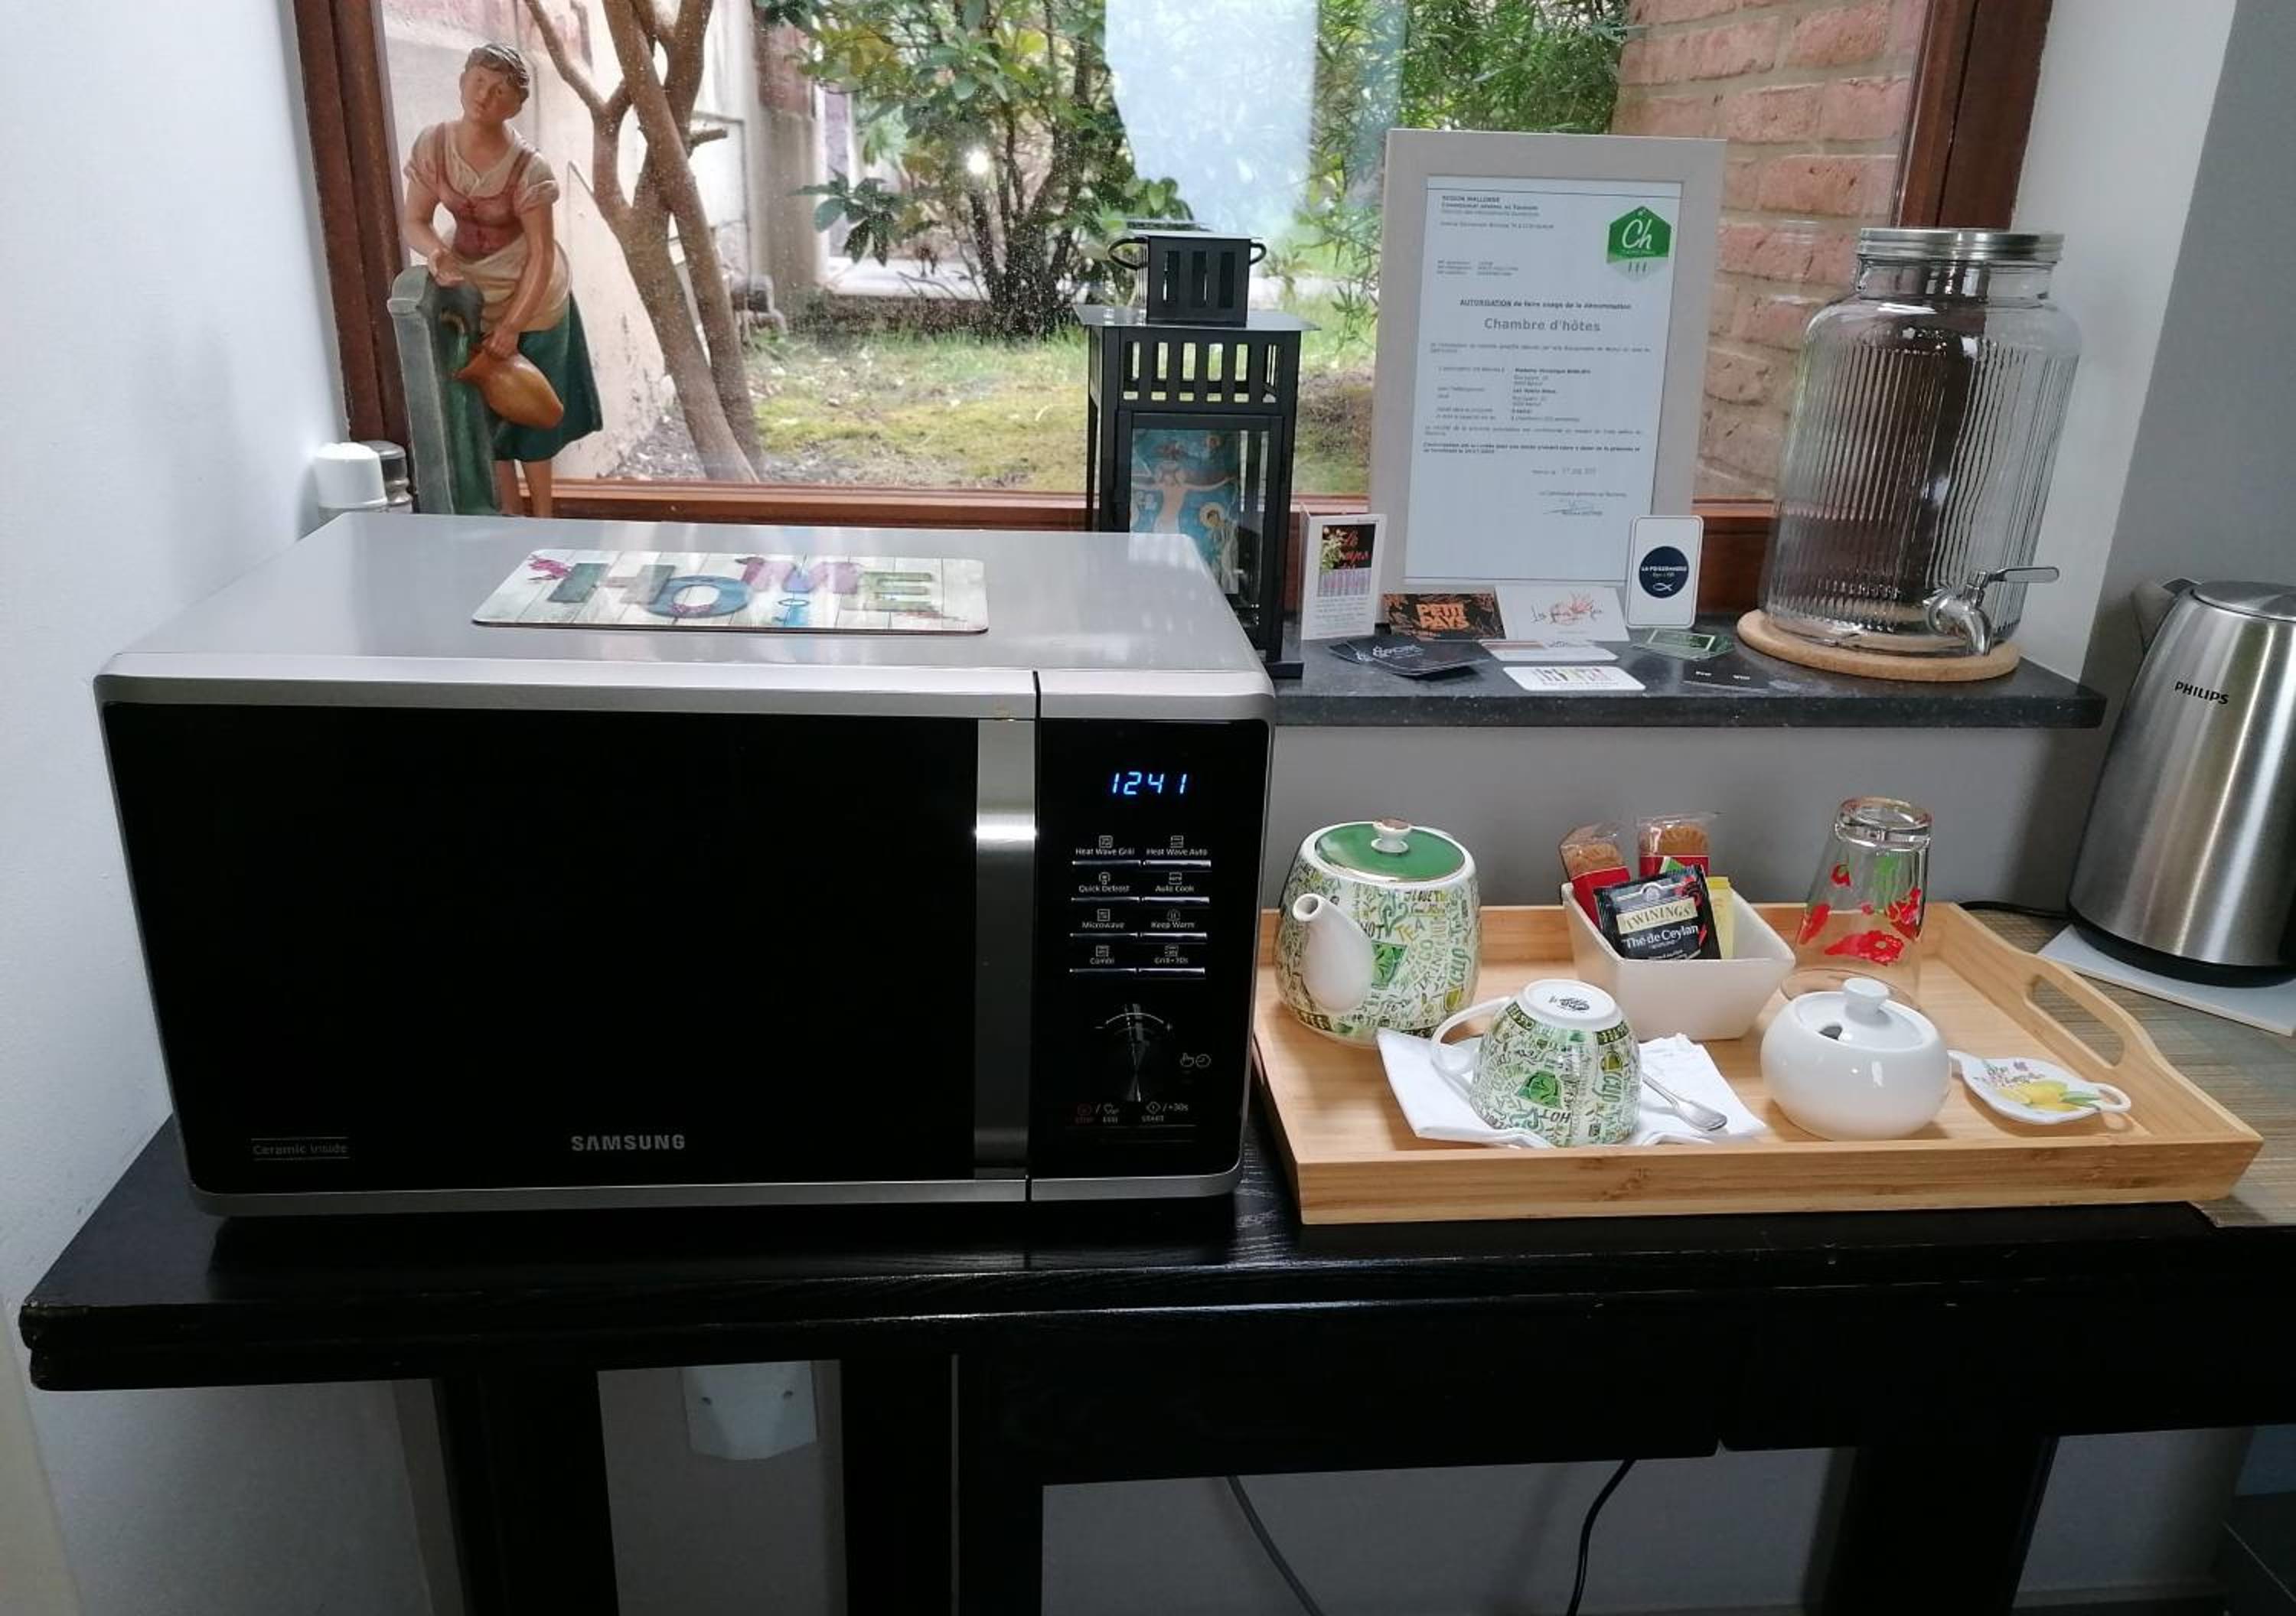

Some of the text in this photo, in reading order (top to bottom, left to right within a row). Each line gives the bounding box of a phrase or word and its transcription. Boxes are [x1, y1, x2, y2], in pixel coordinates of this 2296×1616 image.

[1621, 219, 1652, 250] Ch
[1459, 298, 1512, 307] AUTORISATION
[1484, 317, 1601, 331] Chambre d'hôtes
[1420, 615, 1469, 630] PAYS
[2174, 680, 2229, 705] PHILIPS
[1078, 885, 1101, 894] Quick
[1155, 885, 1195, 893] Auto Cook
[1623, 903, 1691, 930] TWININGS
[1150, 921, 1170, 930] Keep
[1661, 924, 1699, 941] Ceylan
[253, 1144, 307, 1155] Ceramic
[571, 1134, 686, 1152] SAMSUNG
